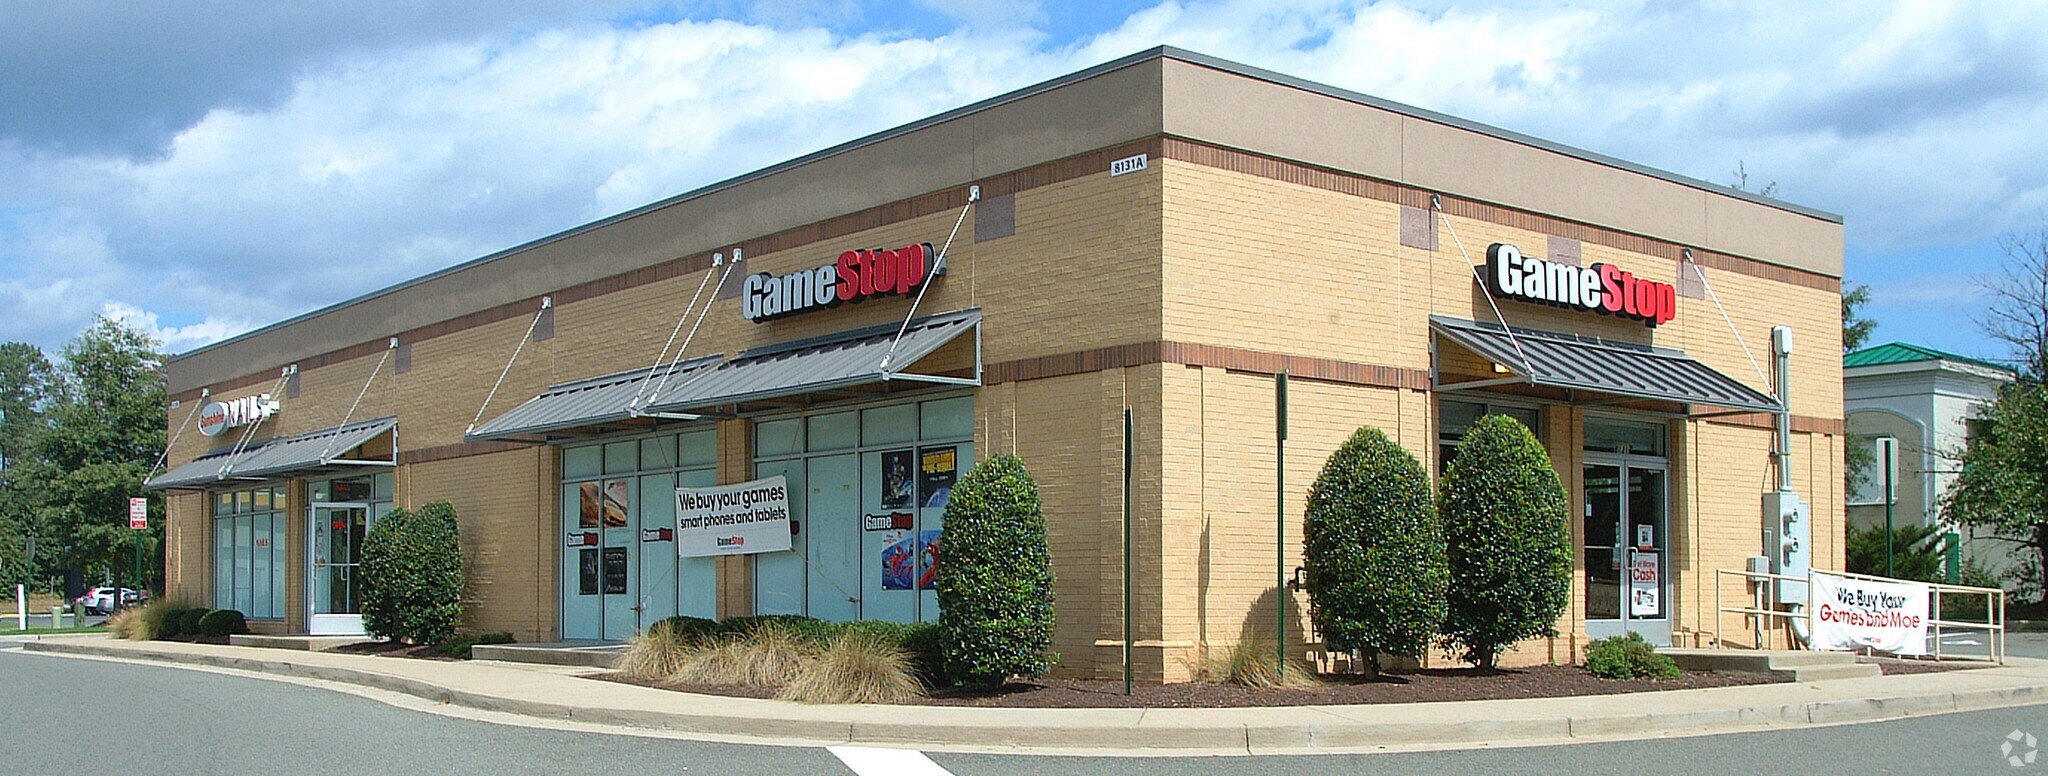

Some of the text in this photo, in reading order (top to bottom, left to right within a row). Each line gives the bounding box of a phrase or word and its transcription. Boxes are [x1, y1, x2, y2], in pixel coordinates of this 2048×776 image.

[1114, 157, 1143, 173] 8131A
[742, 242, 925, 320] GameStop
[1497, 243, 1676, 325] GameStop
[679, 486, 784, 511] We buy your games
[681, 506, 786, 529] smart phones and tablets
[865, 513, 913, 530] GameStop
[1633, 568, 1655, 580] Cash
[1835, 587, 1855, 605] We
[1857, 590, 1877, 612] Buy
[1820, 604, 1864, 626] Games
